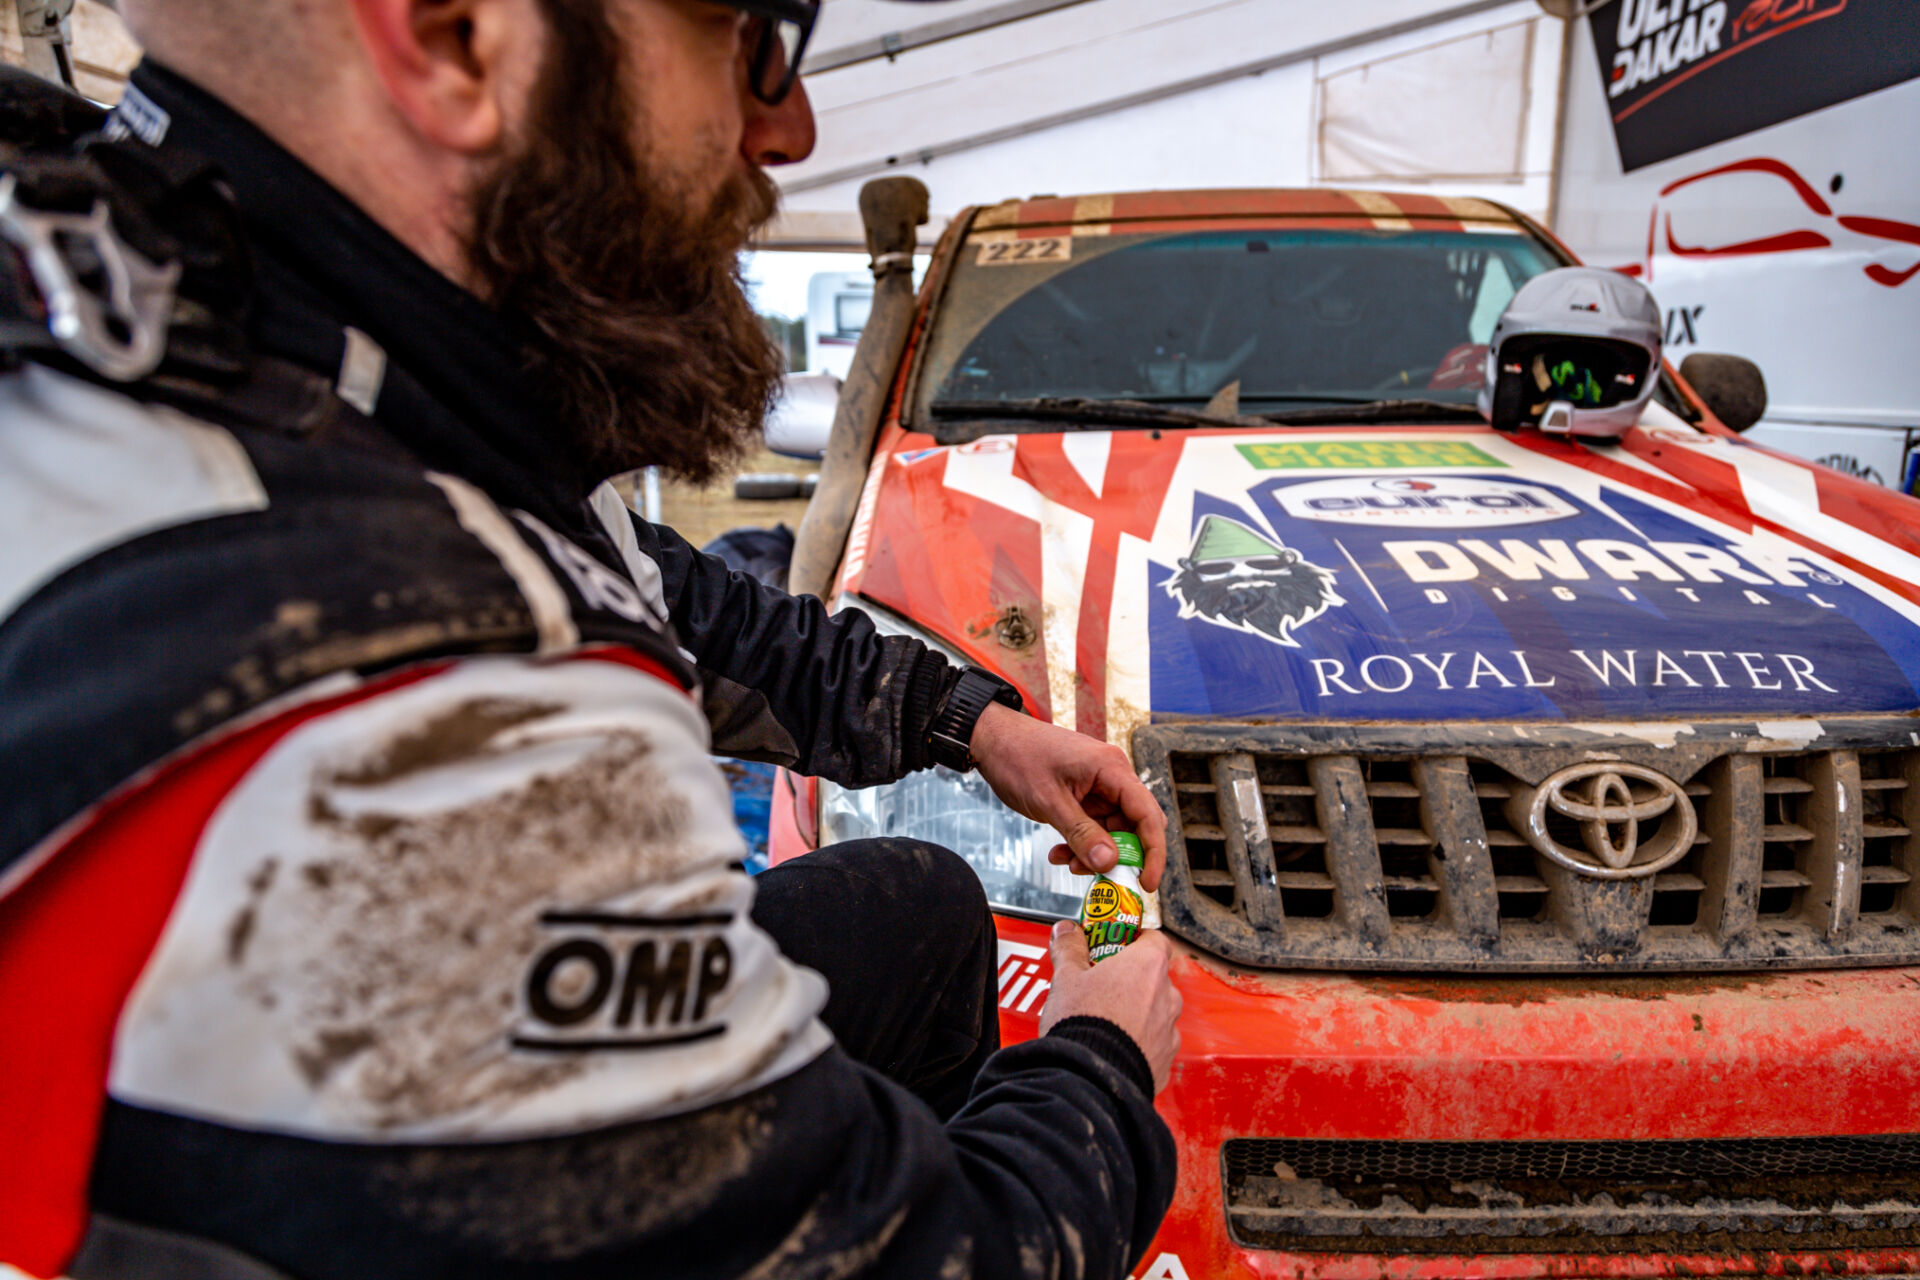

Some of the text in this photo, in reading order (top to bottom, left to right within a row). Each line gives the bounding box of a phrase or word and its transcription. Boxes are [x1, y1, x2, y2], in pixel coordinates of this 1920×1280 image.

[1609, 1, 1727, 98] DAKAR
[986, 239, 1061, 261] 222
[1249, 442, 1474, 456] MANN
[1260, 454, 1494, 468] FILTER
[1305, 491, 1555, 511] eurol
[1382, 539, 1810, 588] DWARF
[1424, 587, 1837, 609] DIGITAL
[1309, 650, 1838, 696] ROYAL WATER
[1116, 913, 1140, 925] ONE
[528, 936, 733, 1028] OMP
